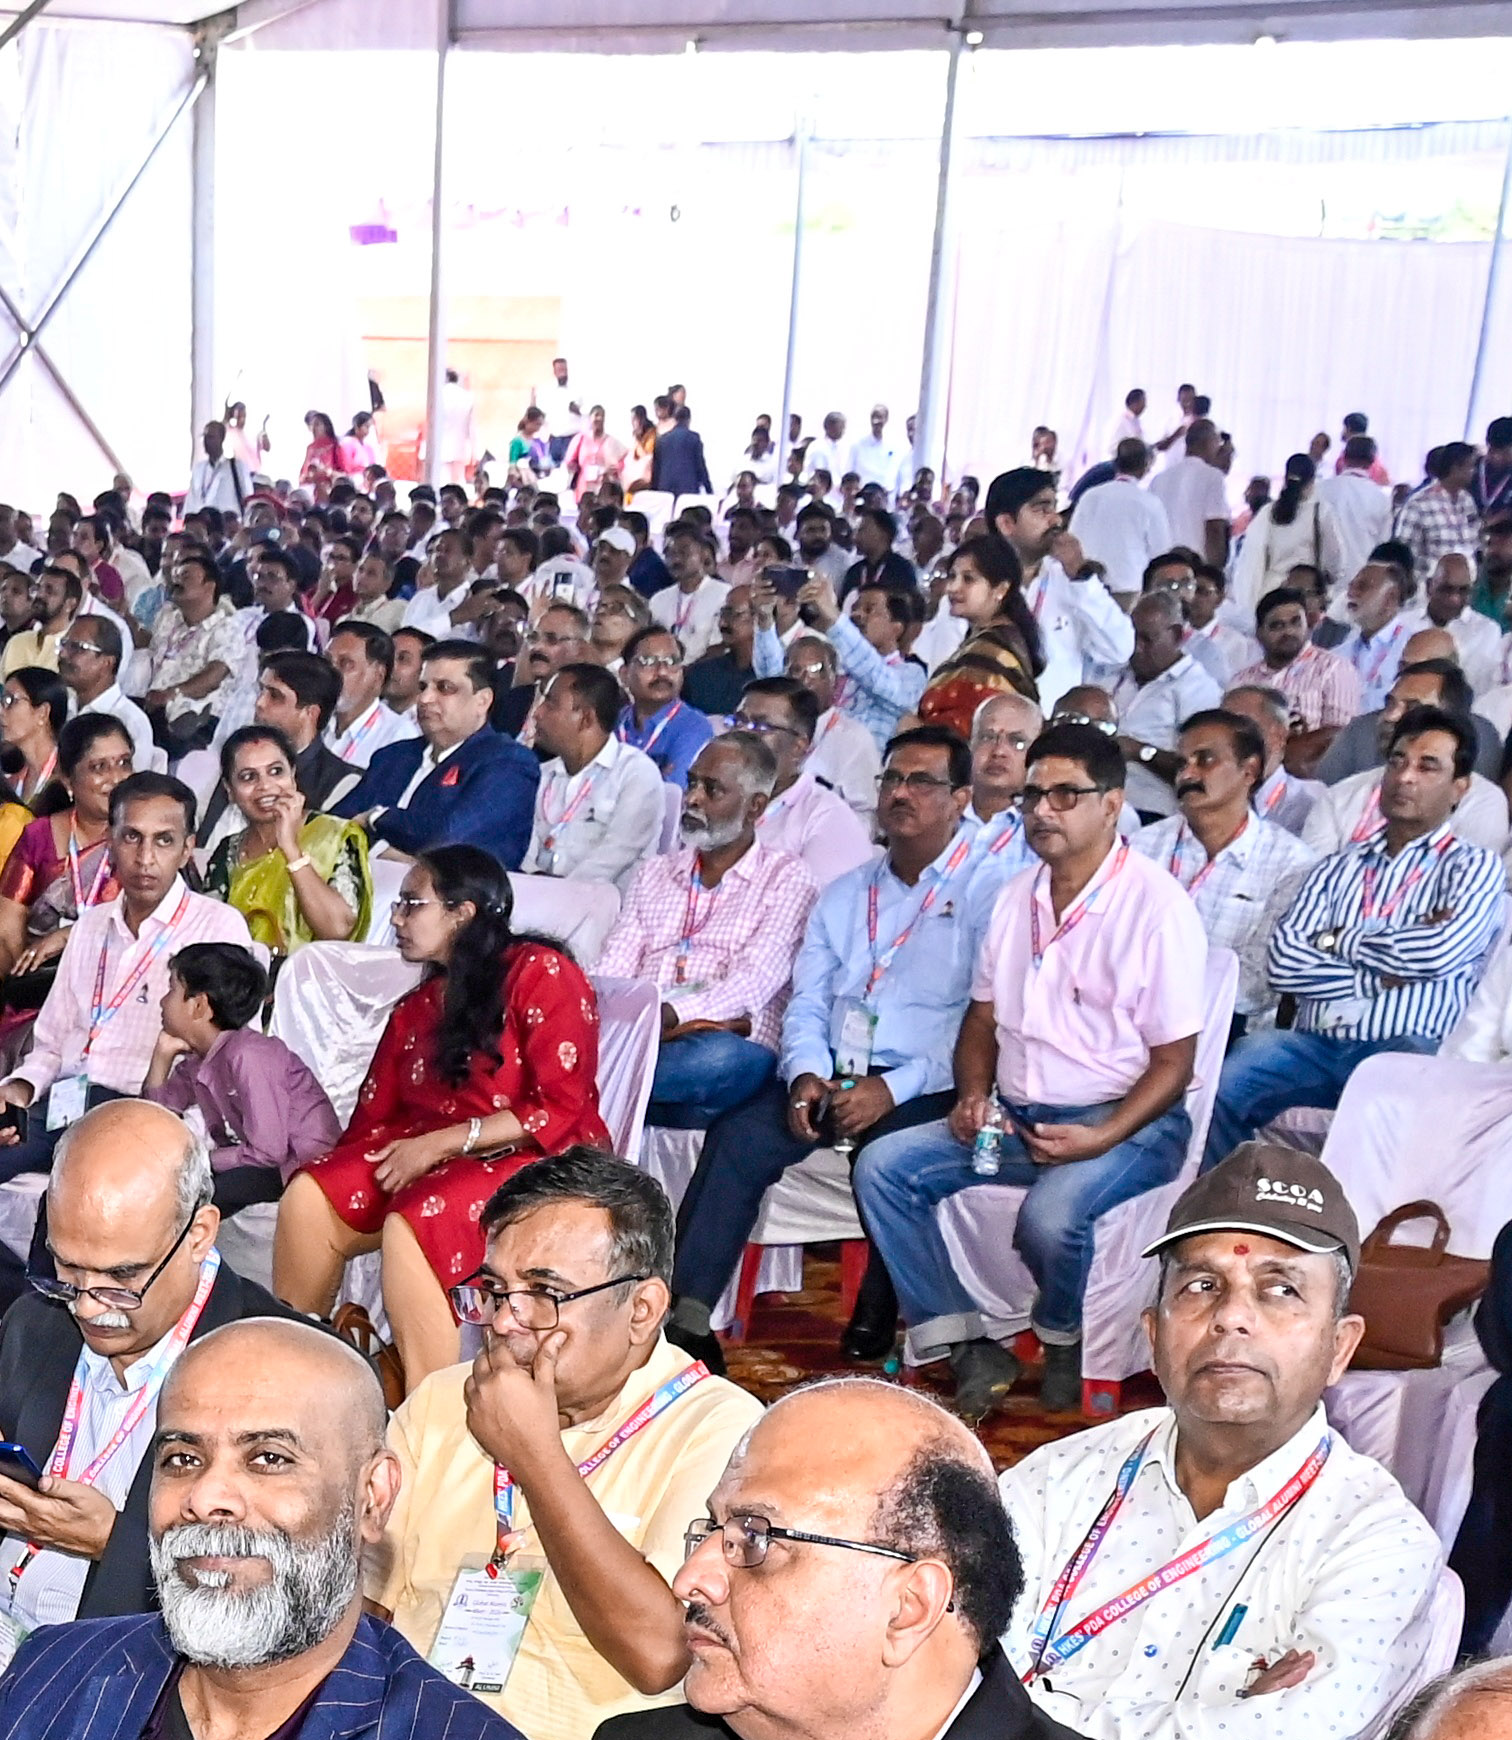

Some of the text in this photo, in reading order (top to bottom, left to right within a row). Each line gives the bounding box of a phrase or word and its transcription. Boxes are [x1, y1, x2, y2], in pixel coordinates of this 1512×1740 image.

[1257, 1177, 1324, 1204] SCOA
[54, 1434, 71, 1473] COLLEGE
[579, 1447, 611, 1476] OLLEGE
[609, 1435, 621, 1450] OF
[1084, 1615, 1105, 1636] PDA
[1103, 1585, 1148, 1622] COLLEGE
[1149, 1576, 1163, 1593] OF
[1237, 1507, 1272, 1540] GLOBAL
[1271, 1478, 1304, 1515] ALUMNI
